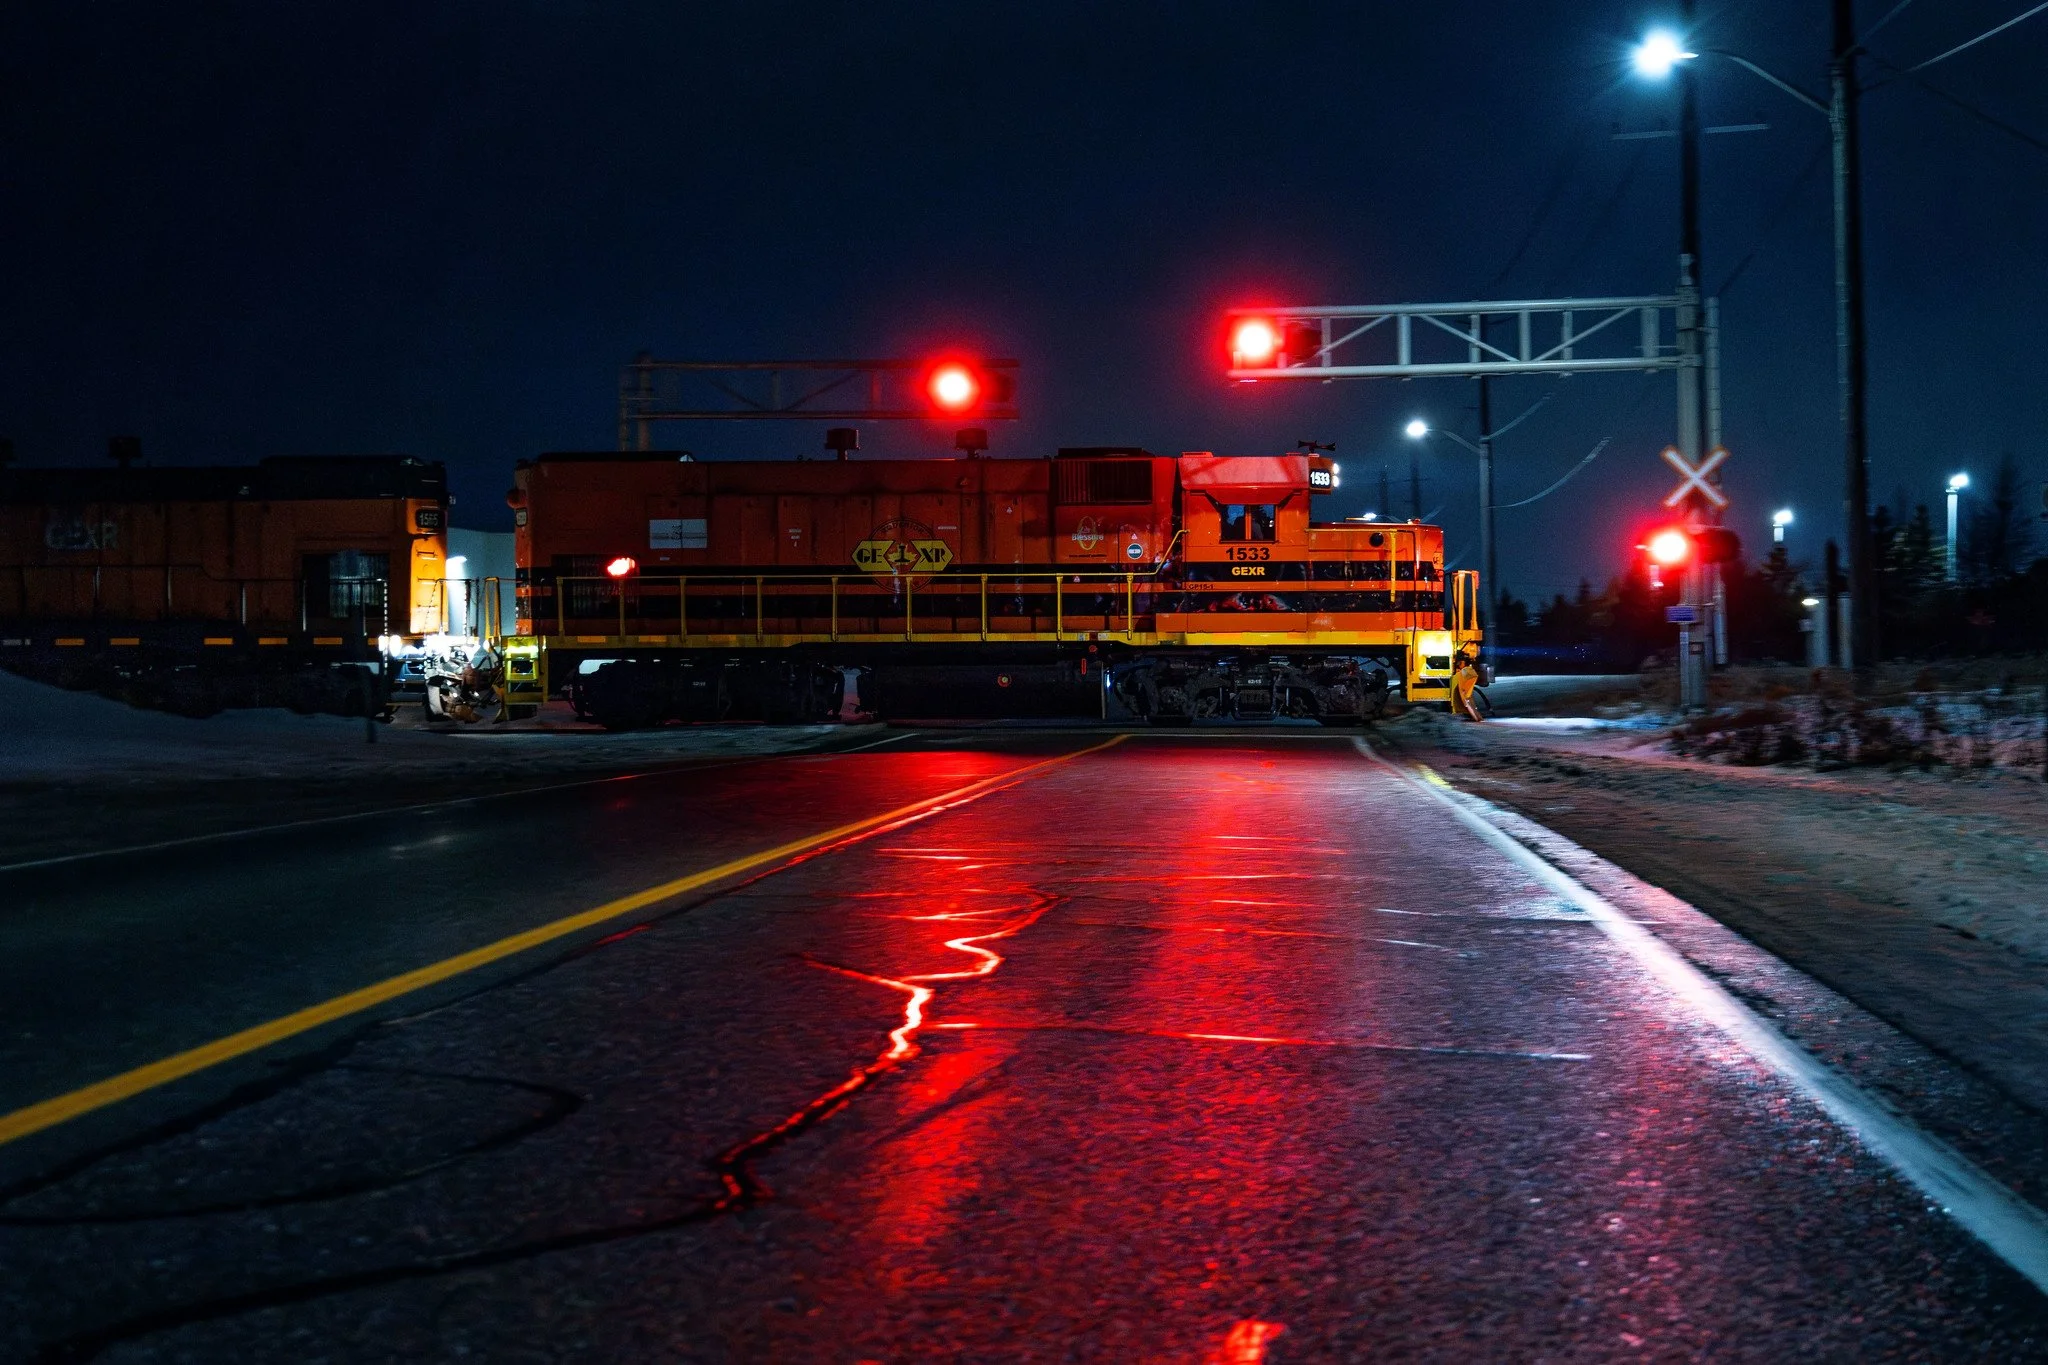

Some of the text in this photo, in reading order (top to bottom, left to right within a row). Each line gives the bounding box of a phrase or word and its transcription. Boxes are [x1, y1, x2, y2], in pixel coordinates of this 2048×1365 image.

[1310, 471, 1330, 486] 1533
[857, 548, 945, 563] GE XR
[1226, 547, 1270, 561] 1533
[1231, 566, 1265, 576] GEXR
